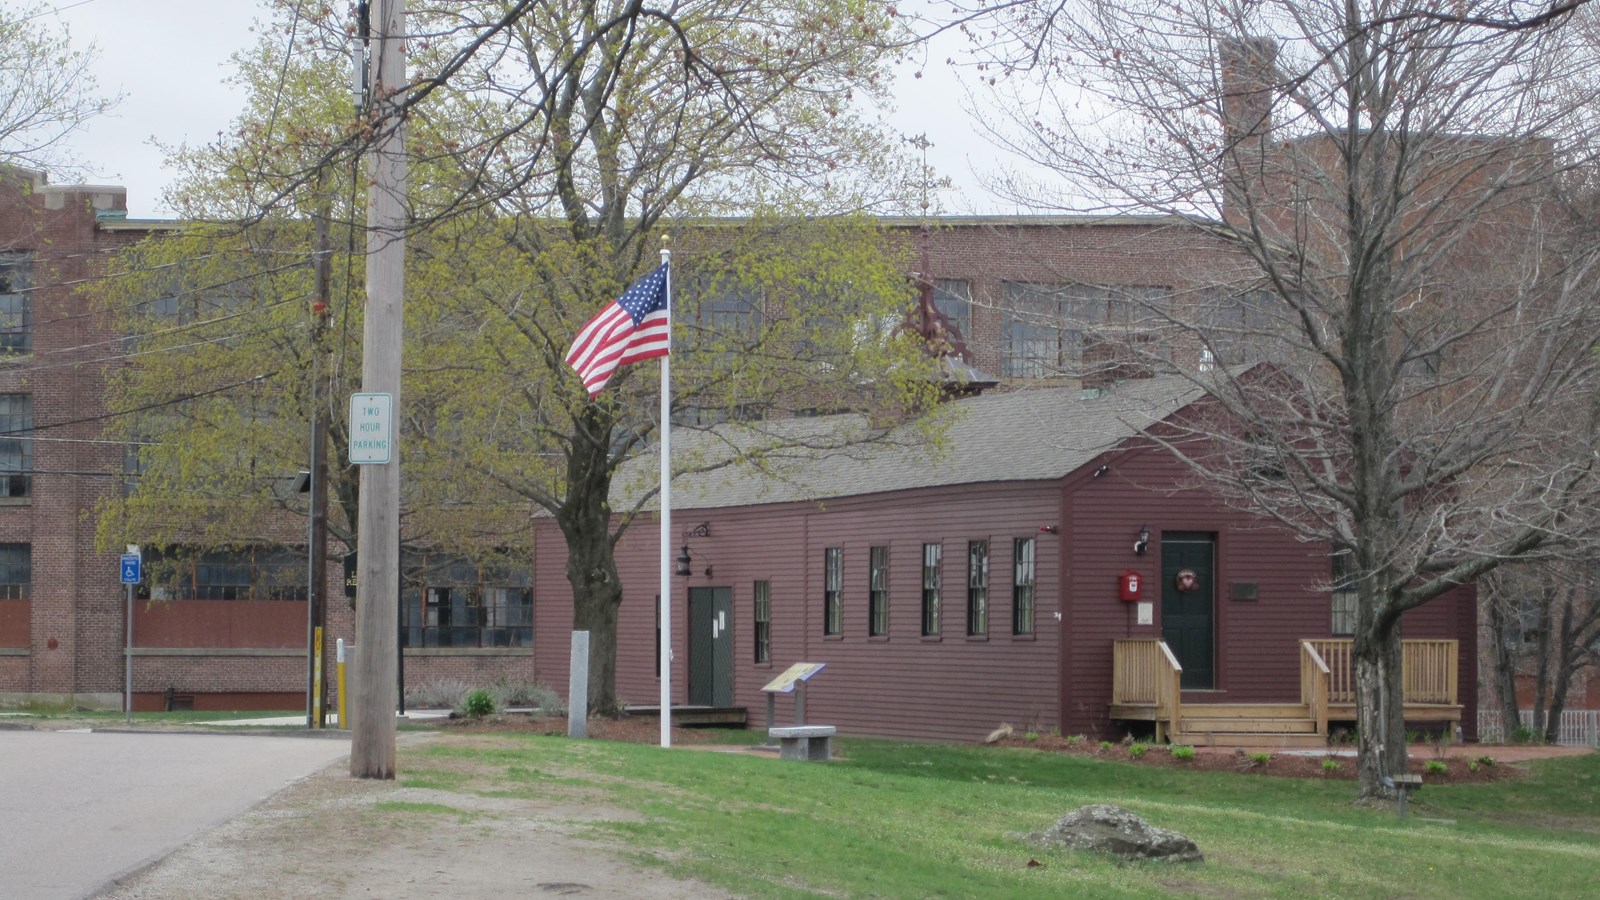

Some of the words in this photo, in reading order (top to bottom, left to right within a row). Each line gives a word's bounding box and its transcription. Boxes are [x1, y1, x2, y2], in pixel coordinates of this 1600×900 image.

[362, 407, 380, 416] TWO
[360, 422, 381, 432] HOUR
[353, 440, 387, 450] PARKING
